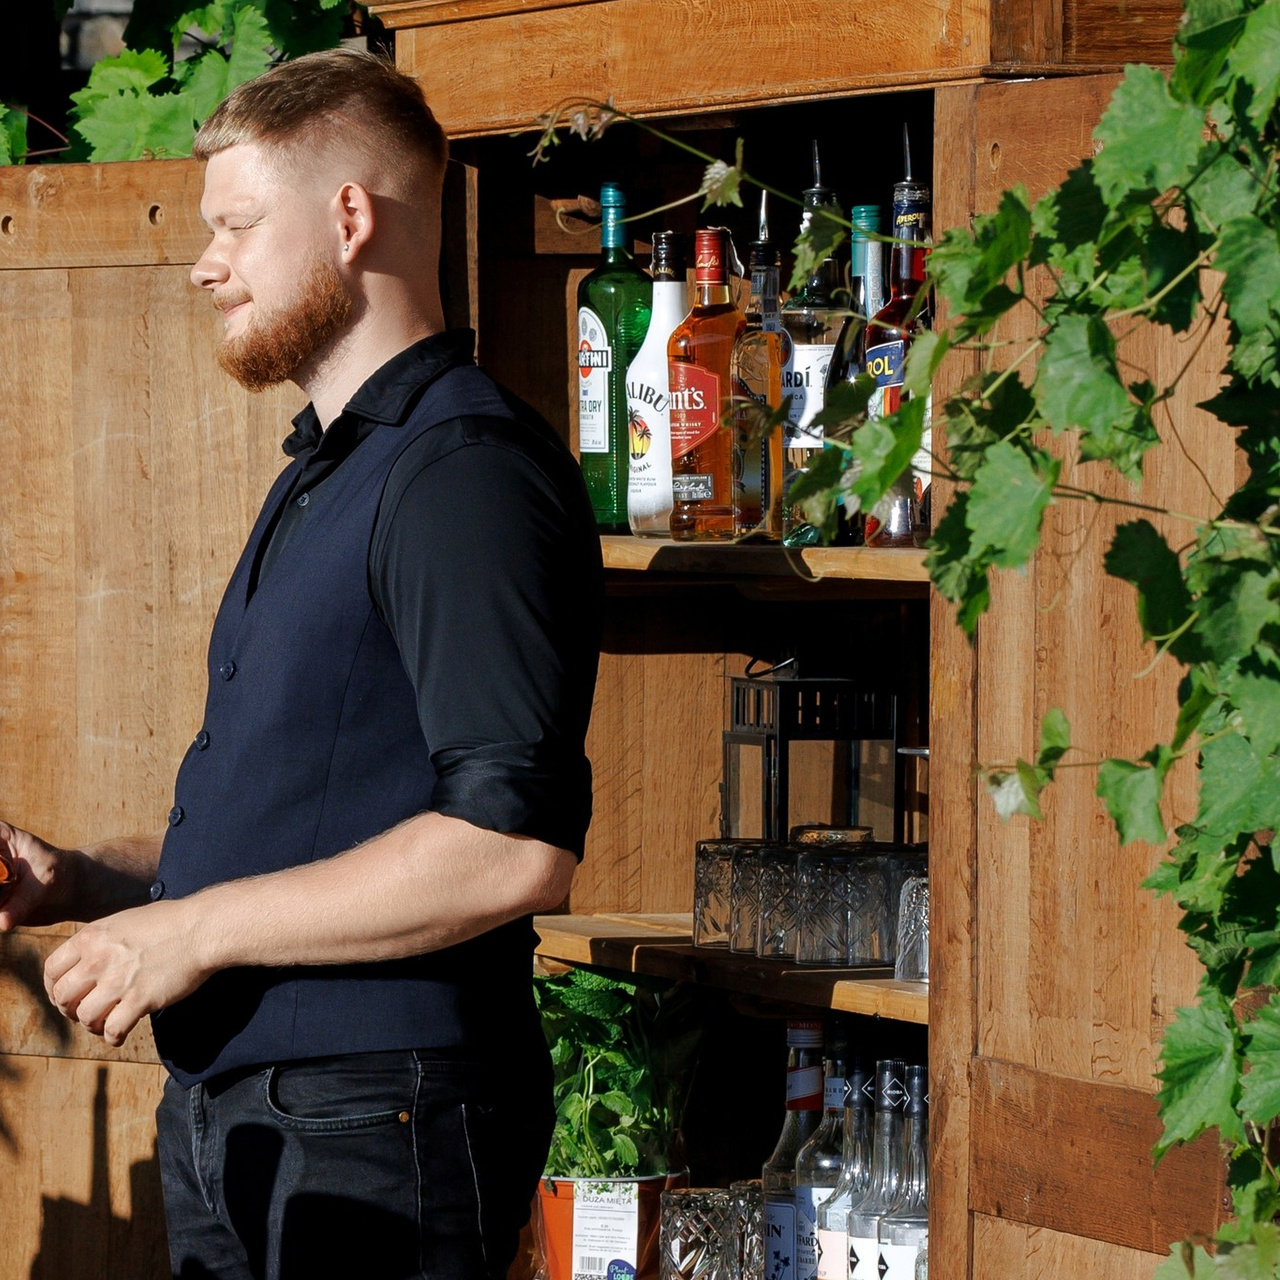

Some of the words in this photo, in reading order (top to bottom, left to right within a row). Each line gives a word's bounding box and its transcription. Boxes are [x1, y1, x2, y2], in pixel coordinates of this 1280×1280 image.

[579, 351, 607, 367] RTINI
[669, 386, 707, 410] nt's.
[588, 400, 602, 413] DRY
